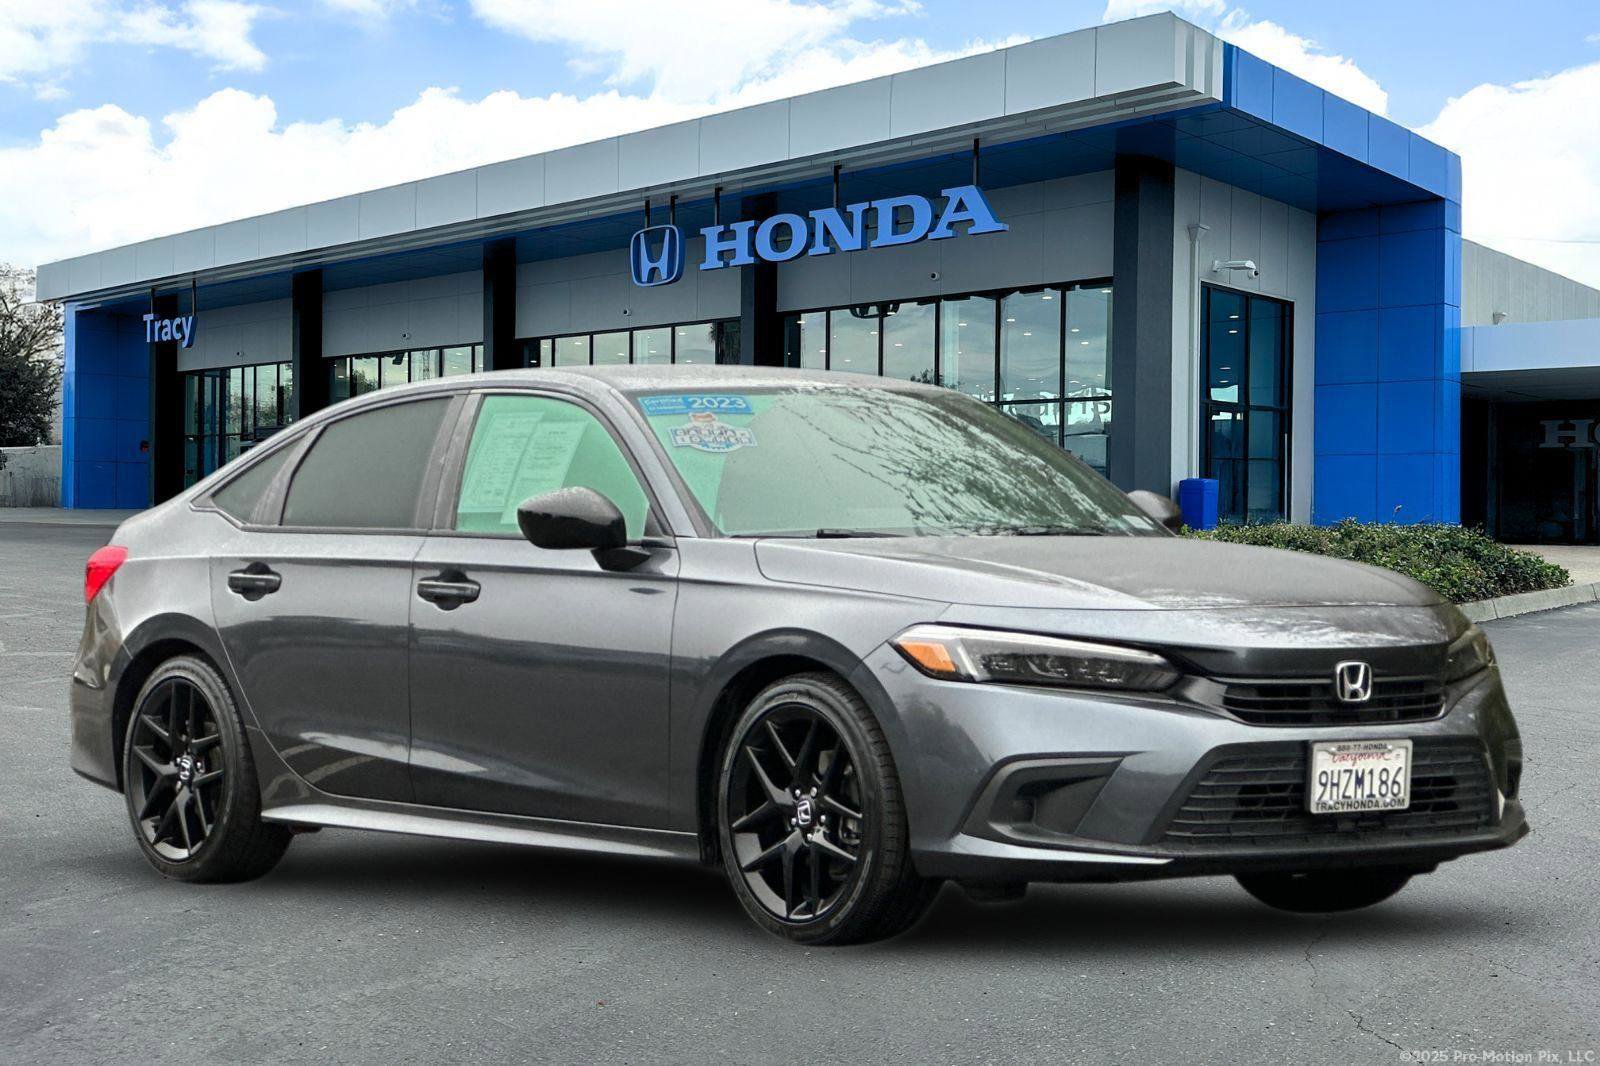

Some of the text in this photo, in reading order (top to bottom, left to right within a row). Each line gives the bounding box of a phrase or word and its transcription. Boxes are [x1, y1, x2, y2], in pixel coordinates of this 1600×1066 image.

[700, 184, 1010, 271] HONDA
[143, 313, 194, 348] Tracy
[689, 397, 747, 409] 2023
[1539, 419, 1600, 448] H
[1317, 766, 1403, 801] 9HZM186
